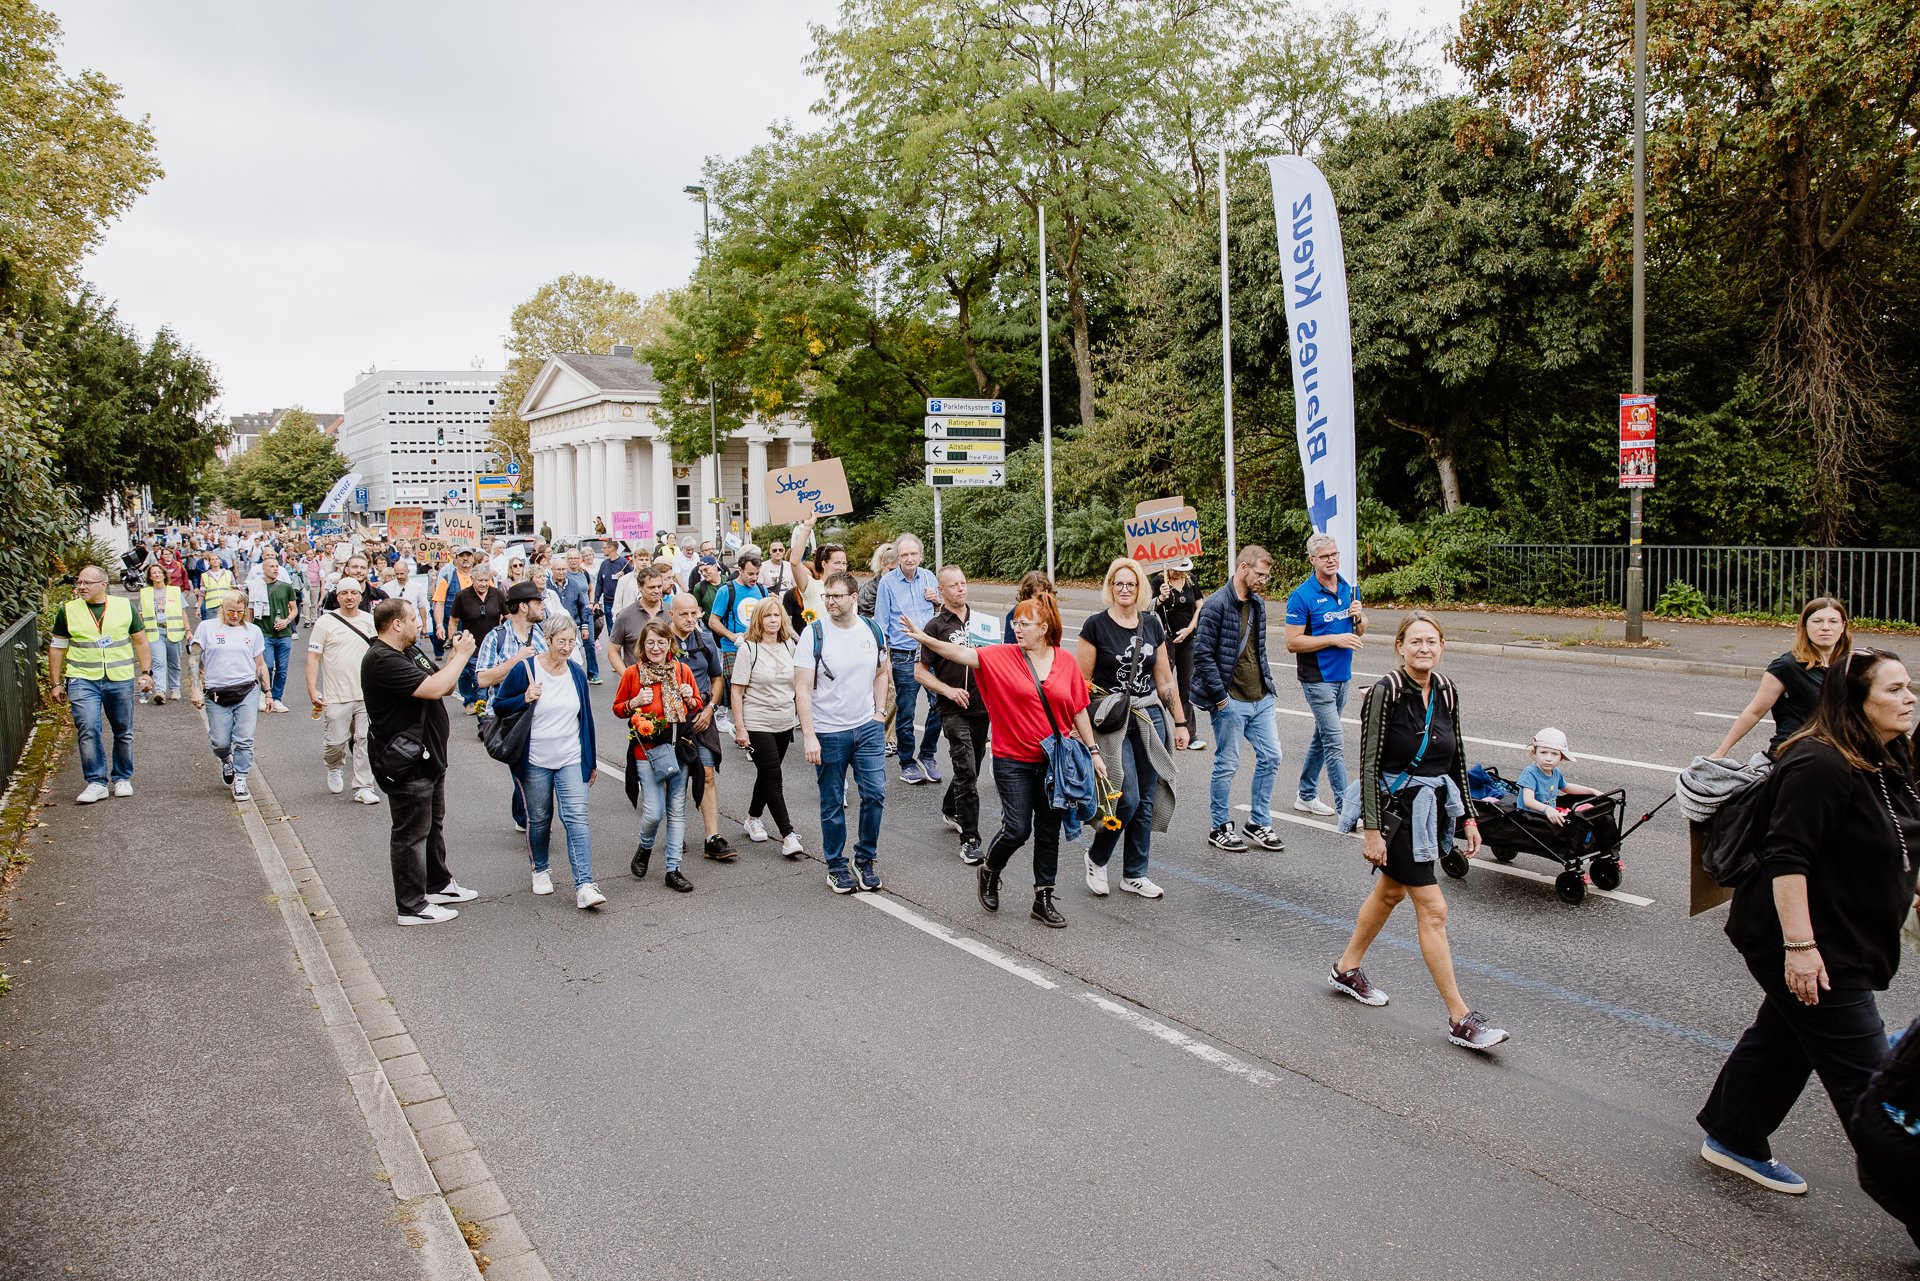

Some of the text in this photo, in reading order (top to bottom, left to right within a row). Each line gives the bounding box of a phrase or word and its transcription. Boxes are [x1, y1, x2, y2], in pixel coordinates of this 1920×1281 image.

[943, 403, 990, 411] Parkleitsystem
[776, 474, 808, 494] Sober
[333, 480, 351, 503] Kreuz
[445, 518, 473, 529] VOLL
[449, 528, 475, 540] SCHÖN
[630, 531, 648, 539] MUT
[451, 537, 468, 546] HIER
[418, 551, 448, 561] SCHAM
[216, 637, 226, 645] 36
